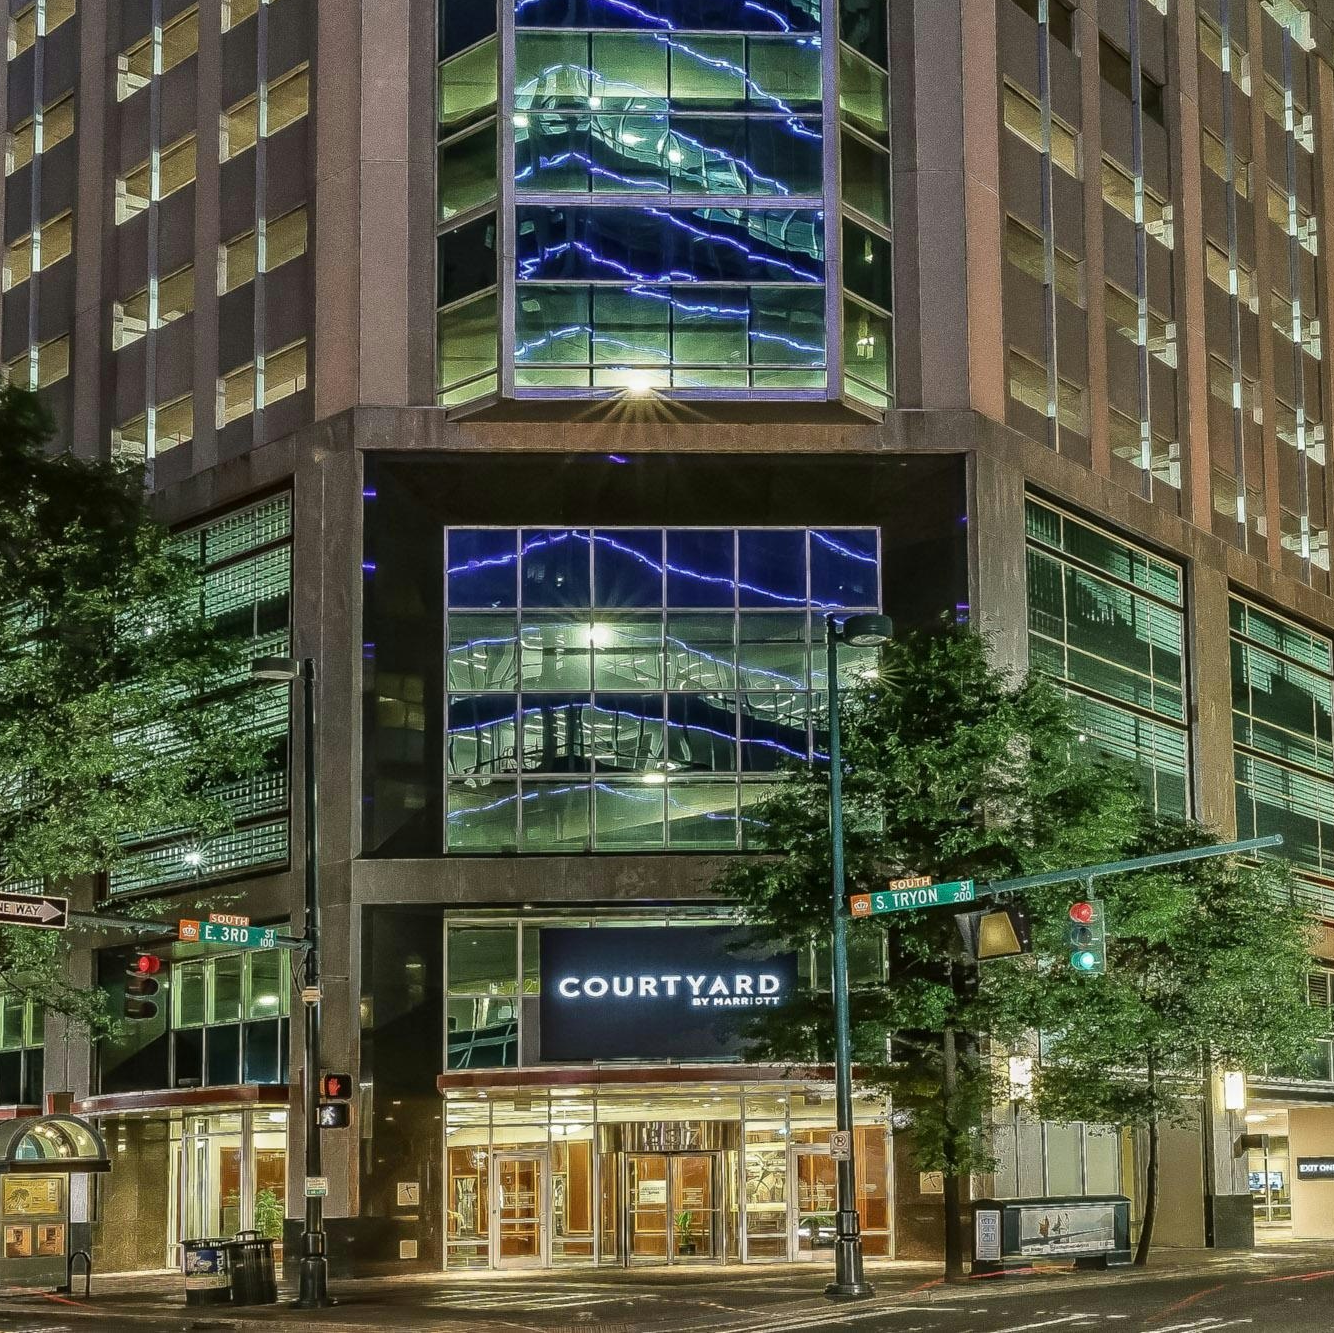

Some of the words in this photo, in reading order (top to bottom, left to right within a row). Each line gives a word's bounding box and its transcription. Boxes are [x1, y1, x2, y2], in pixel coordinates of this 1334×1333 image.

[890, 876, 931, 890] SOUTH
[960, 881, 970, 891] ST
[876, 895, 887, 909] S.
[892, 888, 938, 907] TRYON
[953, 891, 971, 902] 200
[16, 904, 41, 916] WAY
[210, 914, 248, 926] SOUTH
[205, 925, 216, 940] E.
[221, 927, 248, 942] 3RD
[264, 929, 274, 939] ST
[260, 938, 274, 947] 100
[559, 974, 780, 997] COURTYARD
[692, 997, 709, 1006] BY
[713, 996, 780, 1006] MARRIOTT
[1299, 1164, 1318, 1172] EXIT
